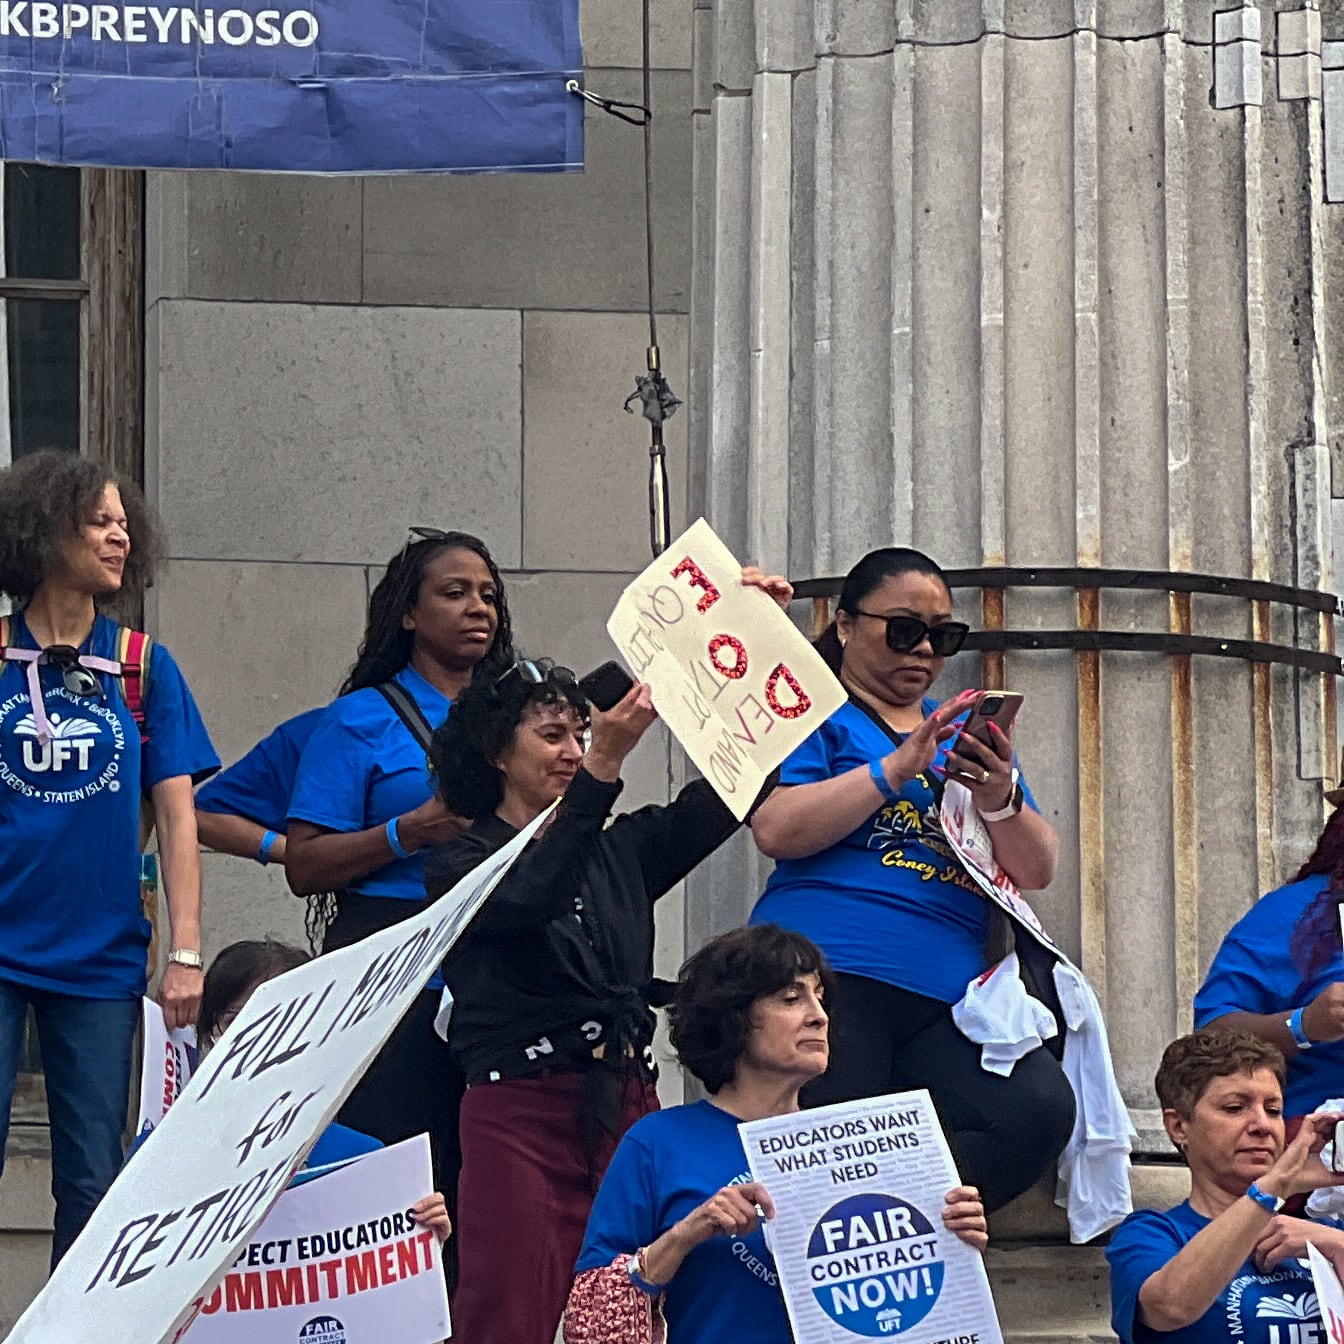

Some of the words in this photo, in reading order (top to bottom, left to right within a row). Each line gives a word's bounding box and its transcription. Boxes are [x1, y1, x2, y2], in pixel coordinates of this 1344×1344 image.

[23, 738, 95, 772] UFT
[43, 790, 84, 803] STATEN
[86, 762, 119, 797] ISLAND
[881, 849, 937, 881] Coney
[759, 1118, 868, 1155] EDUCATORS
[869, 1110, 921, 1135] WANT
[775, 1150, 828, 1174] WHAT
[834, 1132, 920, 1162] STUDENTS
[830, 1161, 878, 1185] NEED
[820, 1206, 918, 1254] FAIR
[731, 1241, 778, 1286] QUEENS
[811, 1240, 939, 1282] CONTRACT
[829, 1267, 935, 1315] NOW!
[305, 1320, 339, 1335] FAIR
[878, 1318, 902, 1333] UFT
